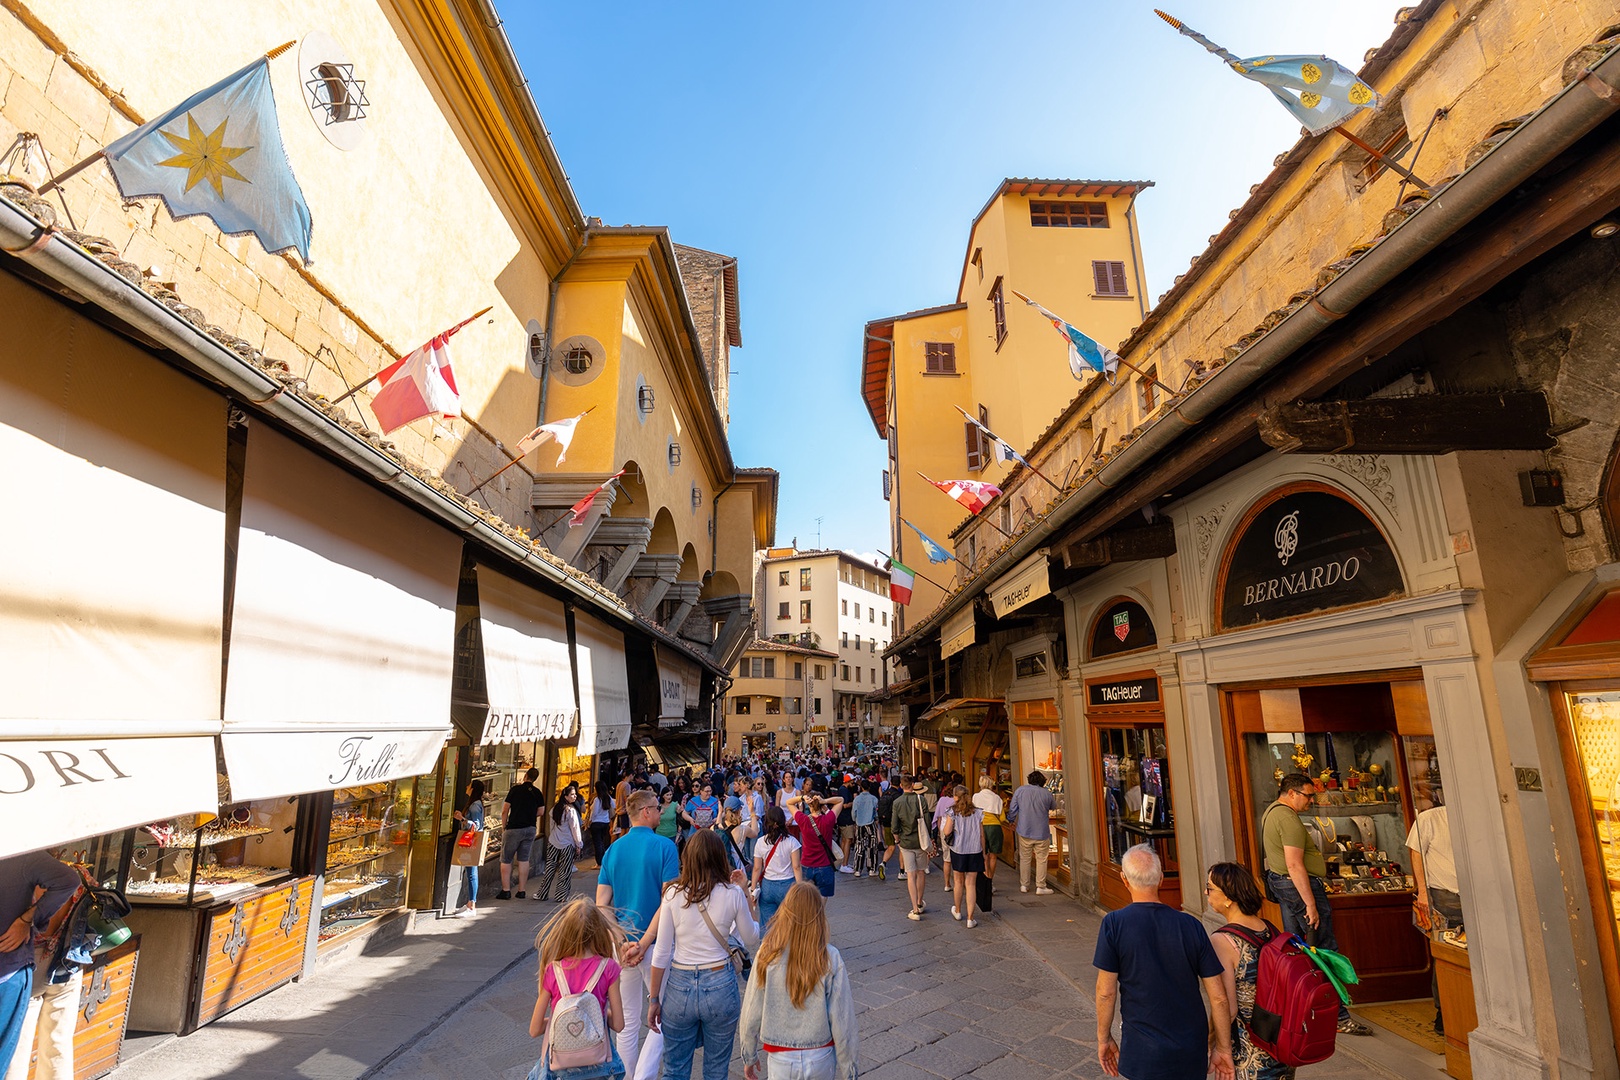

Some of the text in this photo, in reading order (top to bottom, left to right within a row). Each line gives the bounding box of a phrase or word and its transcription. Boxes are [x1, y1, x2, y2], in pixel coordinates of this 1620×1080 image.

[1243, 557, 1360, 606] BERNARDO
[1115, 613, 1128, 625] TAG
[551, 713, 565, 734] 43
[328, 736, 398, 784] Frilli
[1518, 768, 1543, 791] 42
